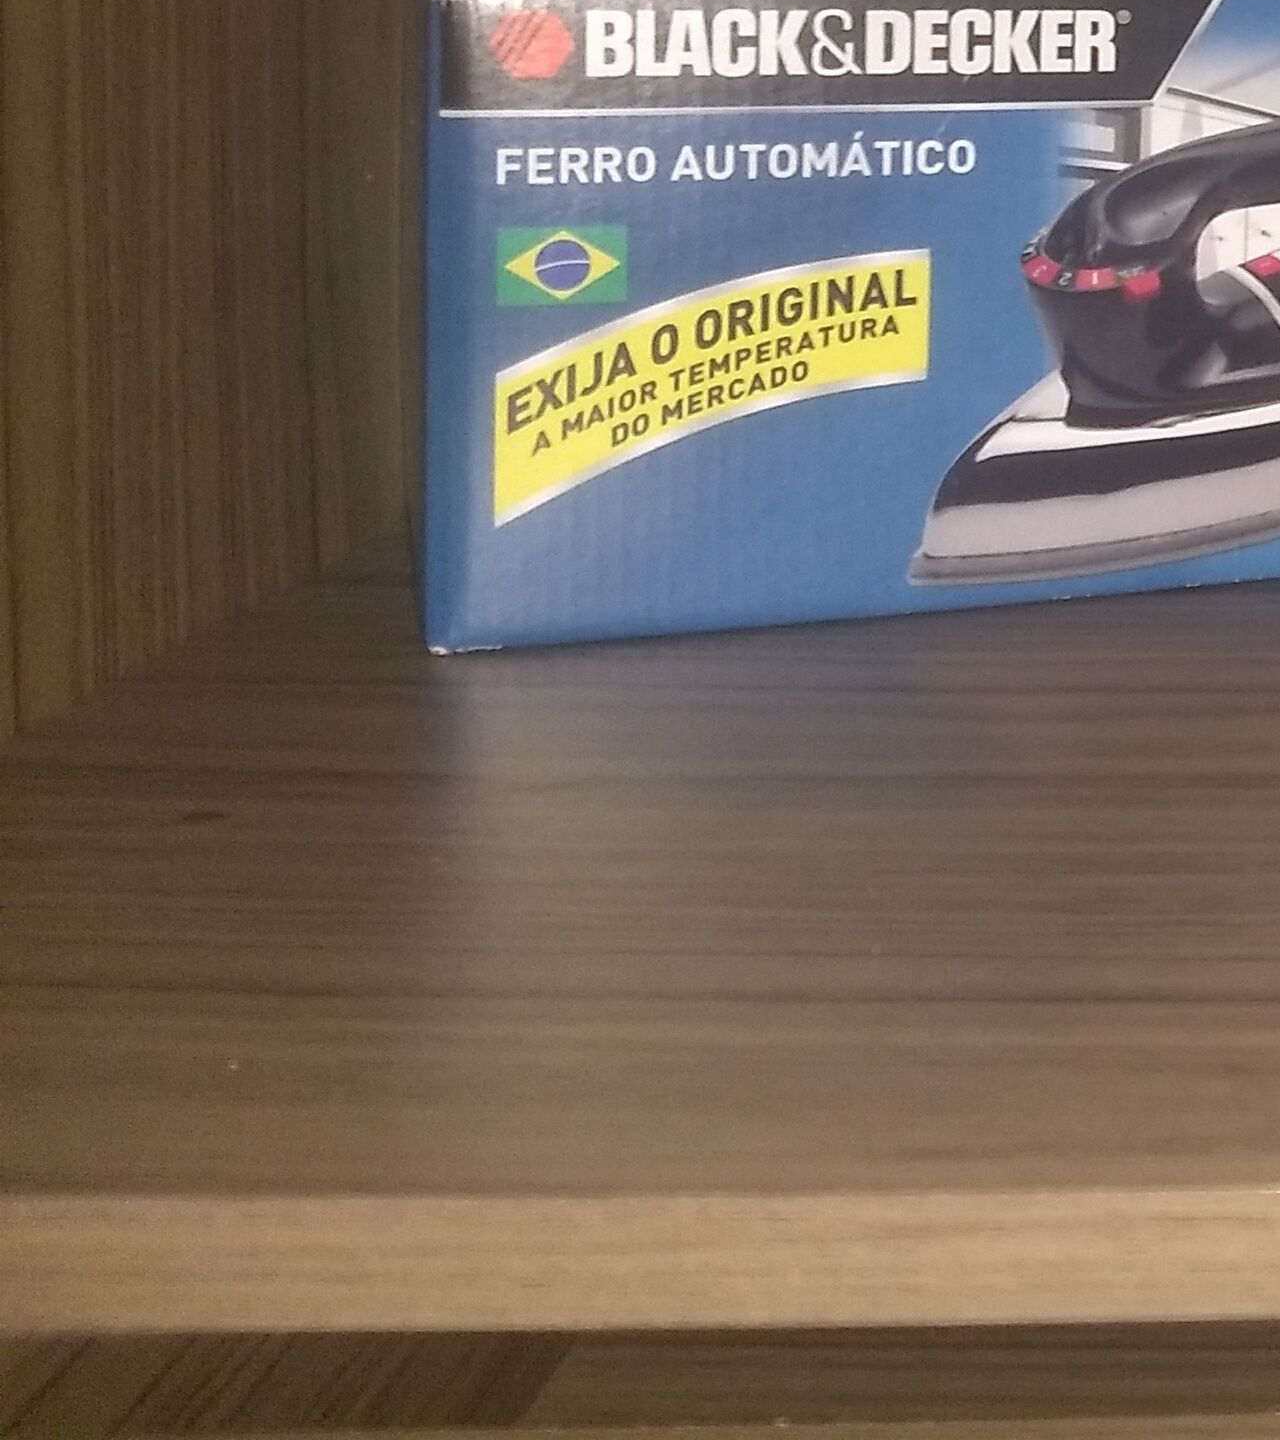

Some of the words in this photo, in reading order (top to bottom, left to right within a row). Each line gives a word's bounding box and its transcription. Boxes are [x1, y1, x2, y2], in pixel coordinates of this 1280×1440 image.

[585, 9, 1118, 78] BLACK&DECKER
[496, 146, 657, 186] FERRO
[670, 131, 977, 182] AUTOMÁTICO
[505, 341, 637, 435] EXIJA
[650, 323, 680, 366] O
[694, 269, 918, 350] ORIGINAL
[531, 431, 552, 457] A
[559, 379, 658, 442] MAIOR
[668, 314, 901, 393] TEMPERATURA
[609, 412, 651, 448] DO
[660, 360, 810, 430] MERCADO
